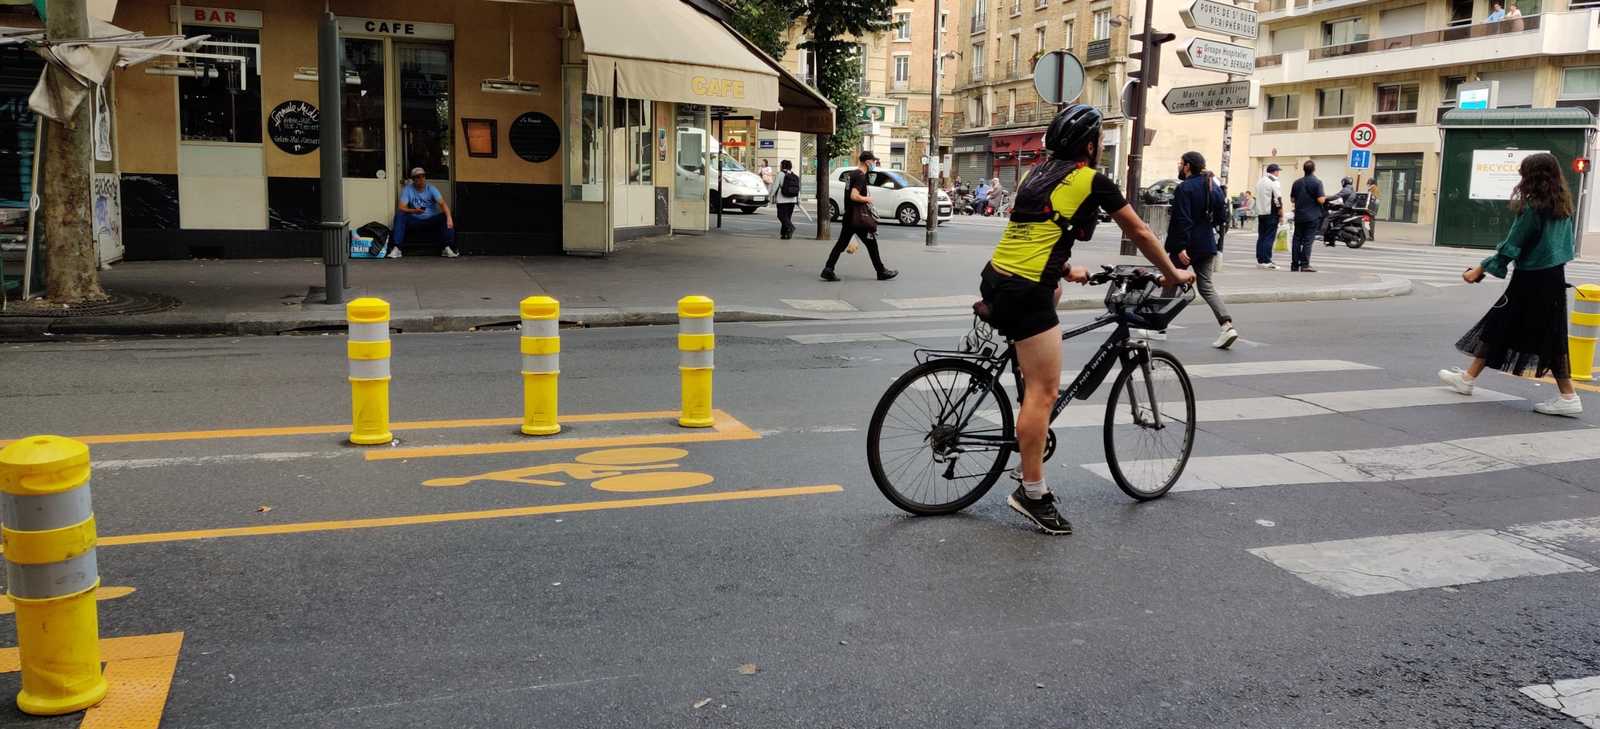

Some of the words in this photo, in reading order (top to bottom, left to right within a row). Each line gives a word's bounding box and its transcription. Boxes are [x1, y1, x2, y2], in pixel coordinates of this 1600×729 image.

[195, 9, 236, 23] BAR
[1200, 3, 1220, 16] PORTE
[1222, 8, 1230, 18] DE
[365, 21, 414, 34] CAFE
[691, 76, 745, 98] CAFE
[1356, 130, 1372, 142] 30
